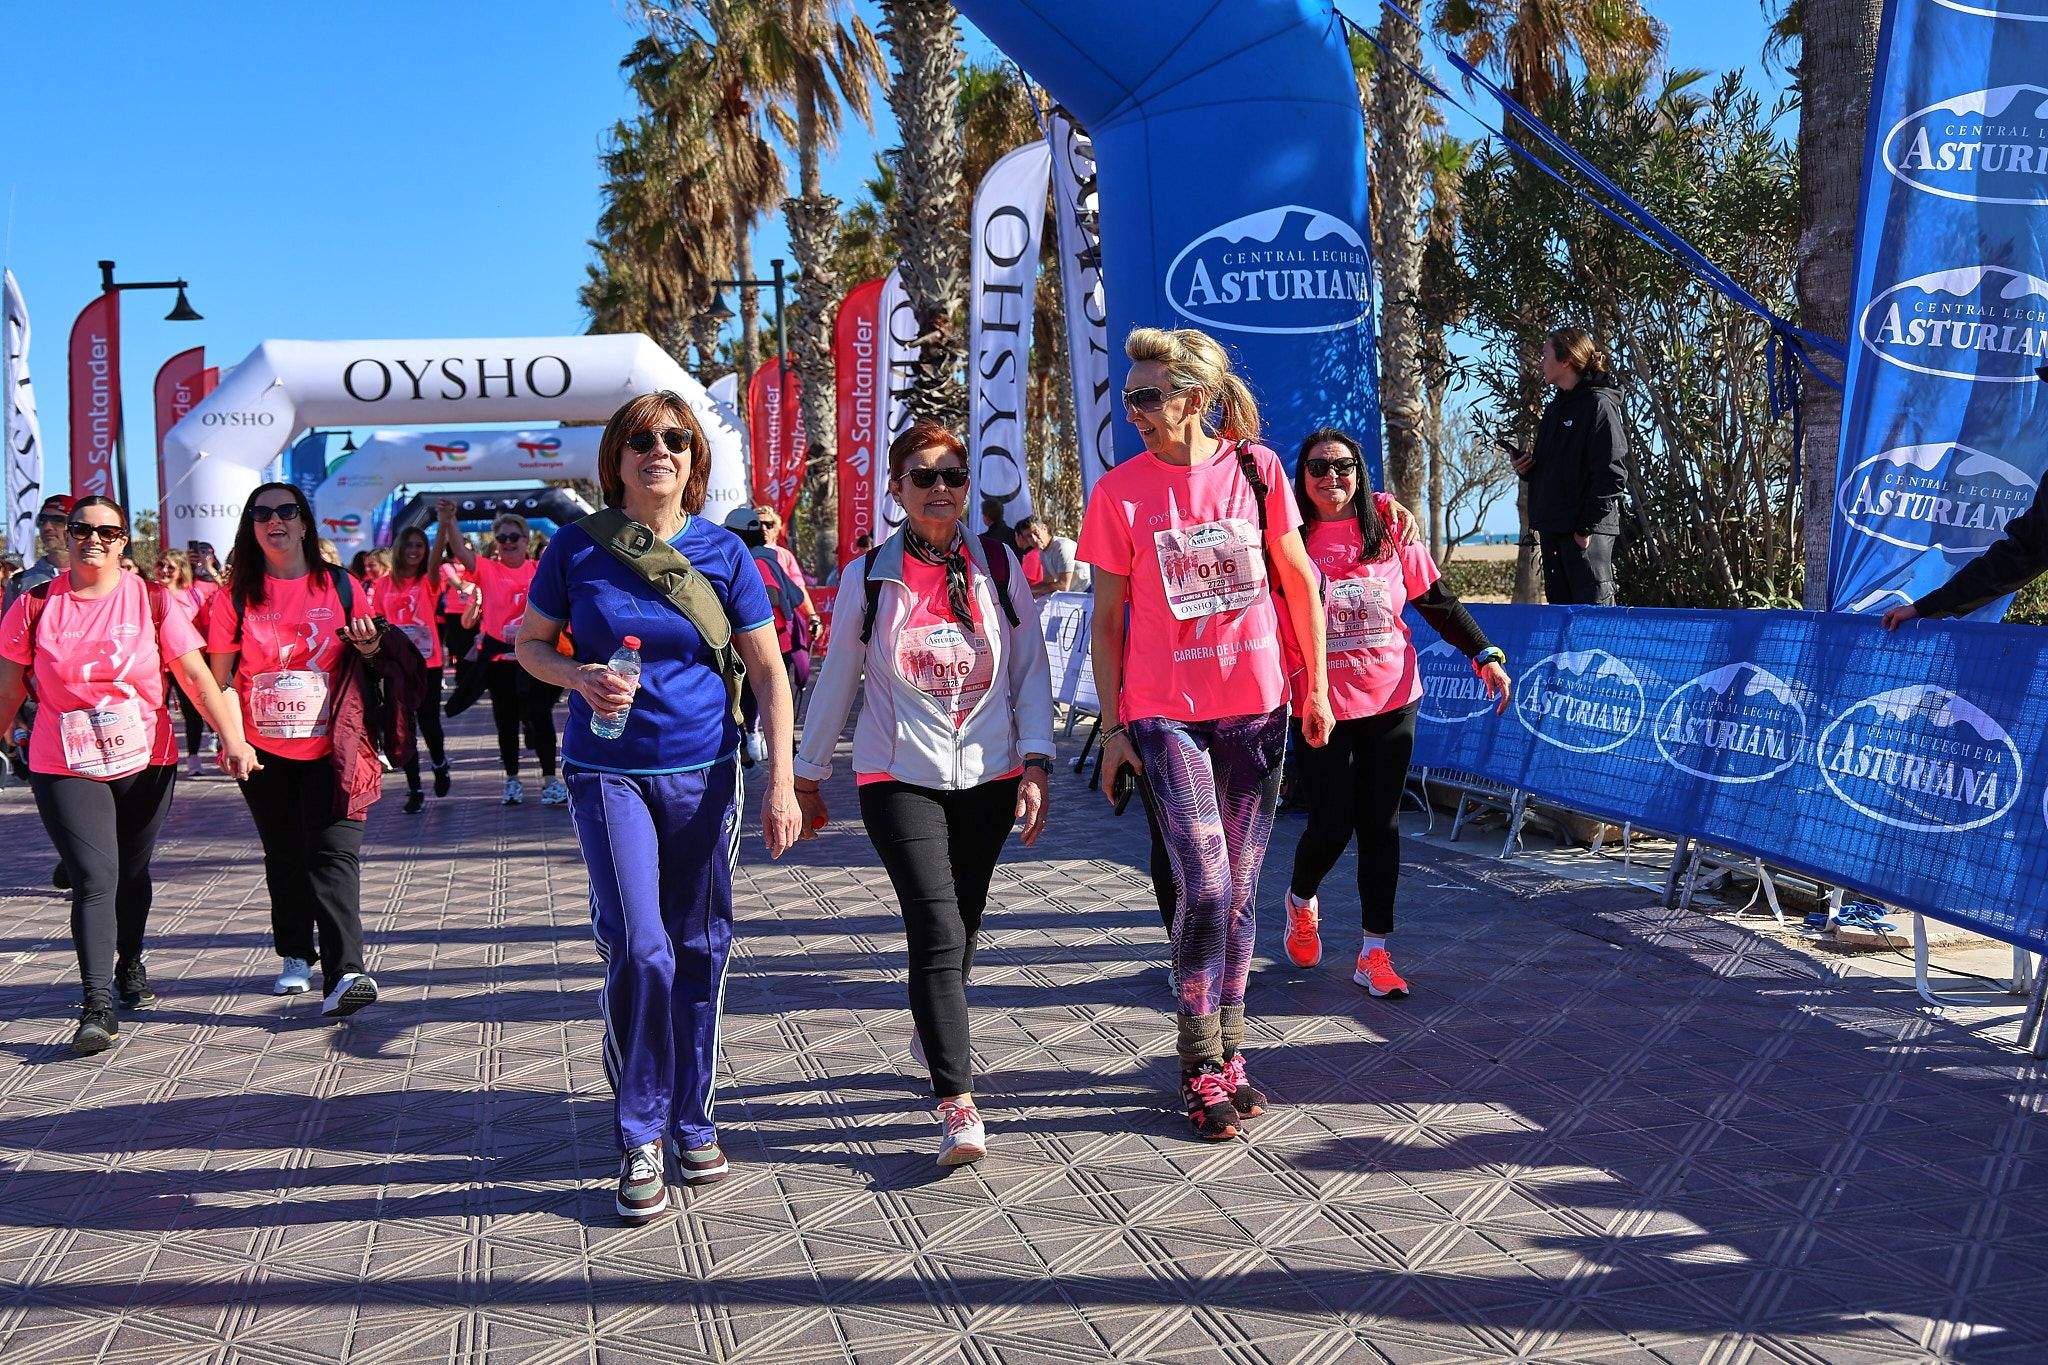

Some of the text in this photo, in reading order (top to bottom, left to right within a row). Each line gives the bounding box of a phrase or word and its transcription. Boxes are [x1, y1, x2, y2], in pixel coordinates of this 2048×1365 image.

[1946, 125, 2029, 137] CENTRAL
[1223, 250, 1305, 265] CENTRAL
[1185, 258, 1369, 307] ASTURIANA
[1914, 301, 1995, 317] CENTRAL
[979, 205, 1030, 503] OYSHO
[343, 355, 573, 402] OYSHO
[853, 316, 873, 442] Santander
[88, 334, 108, 464] Santander
[202, 412, 275, 427] OYSHO
[1885, 473, 2029, 502] CENTRAL LECHERA
[174, 503, 241, 519] OYSHO
[462, 498, 539, 511] OLVO
[1150, 509, 1187, 526] OYSHO
[1197, 559, 1236, 578] 016
[1181, 601, 1212, 613] OYSHO
[1338, 608, 1369, 623] 016
[1173, 645, 1215, 663] CARRERA
[1217, 643, 1230, 657] DE
[1231, 641, 1244, 653] LA
[933, 660, 970, 679] 016
[277, 700, 306, 712] 016
[1520, 674, 1631, 733] ASTURIANA
[95, 735, 125, 750] 016
[1828, 724, 1998, 810] ASTURIANA
